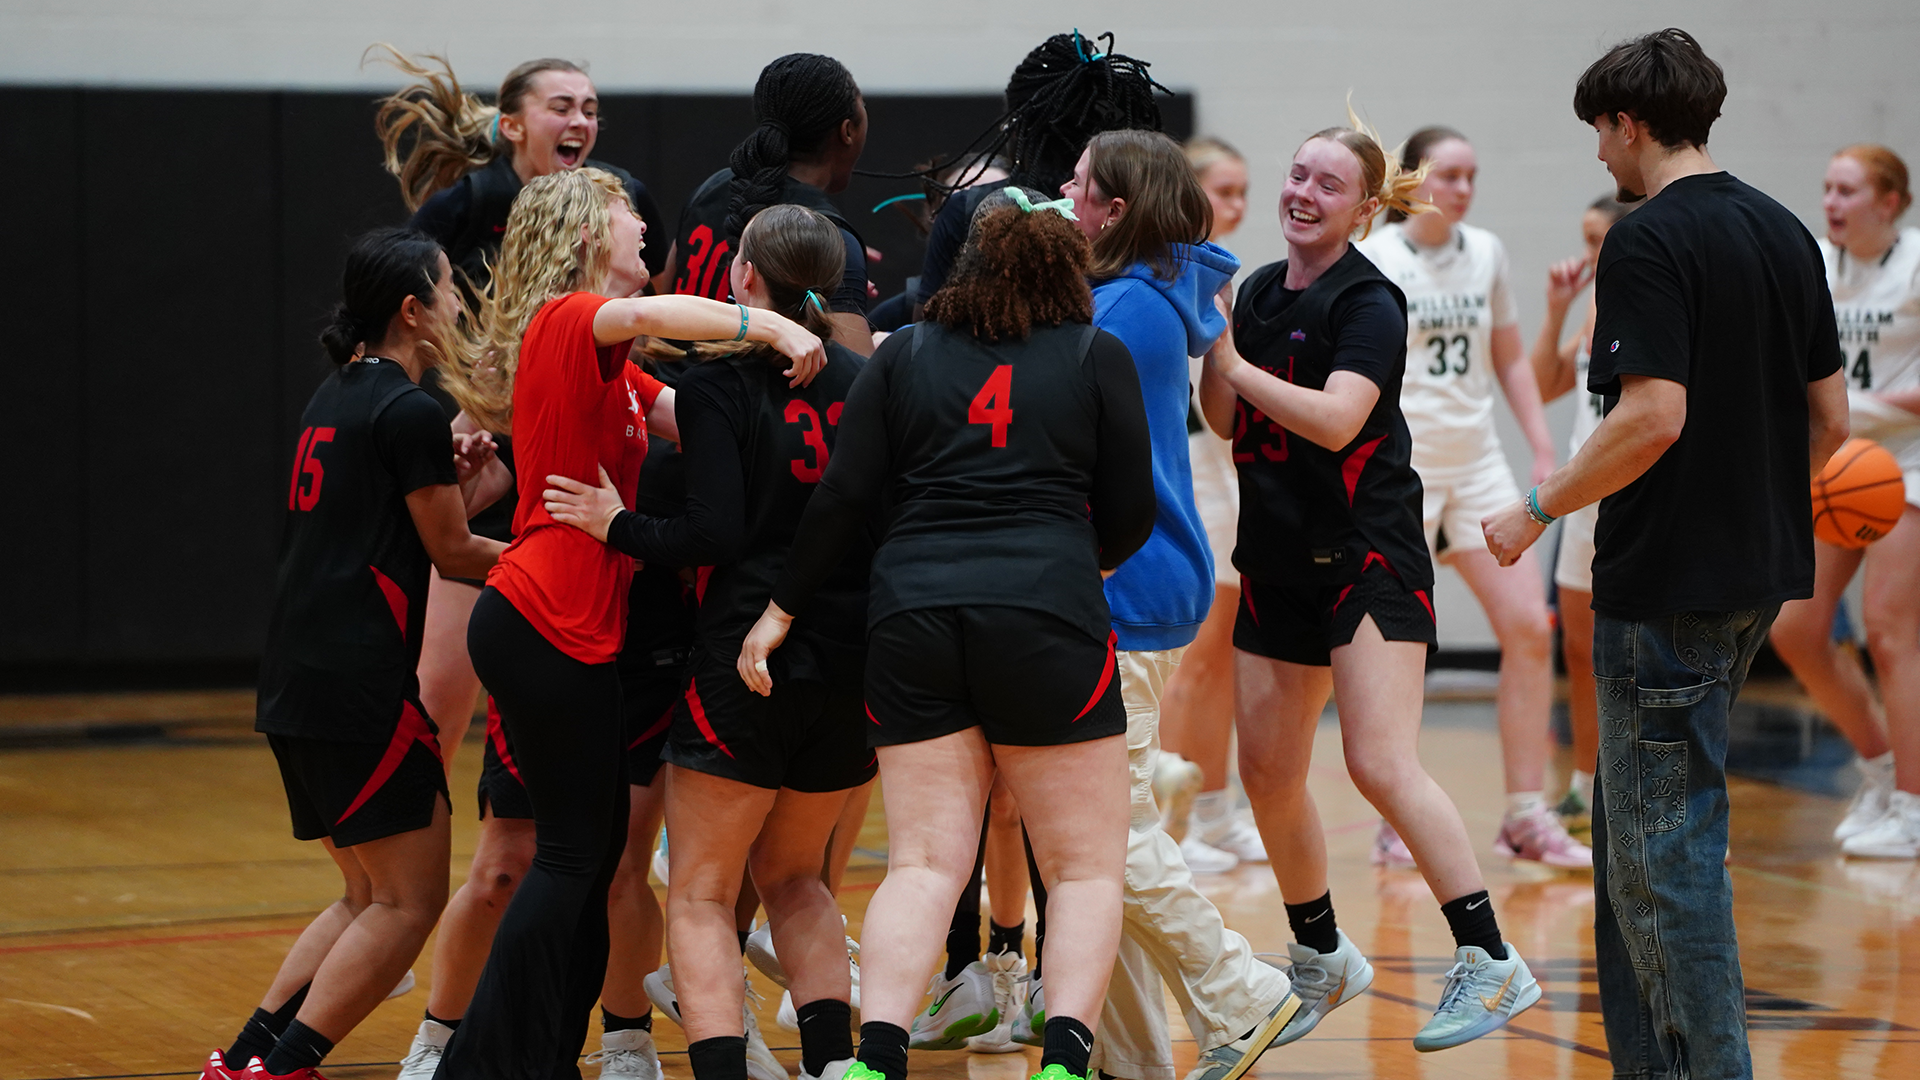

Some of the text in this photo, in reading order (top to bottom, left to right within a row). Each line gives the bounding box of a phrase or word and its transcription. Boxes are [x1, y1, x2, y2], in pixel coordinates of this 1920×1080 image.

[1407, 294, 1486, 312] WILLIAM
[1419, 314, 1478, 330] SMITH
[1427, 335, 1469, 375] 33
[968, 365, 1013, 448] 4
[288, 427, 337, 512] 15
[784, 399, 845, 484] 3
